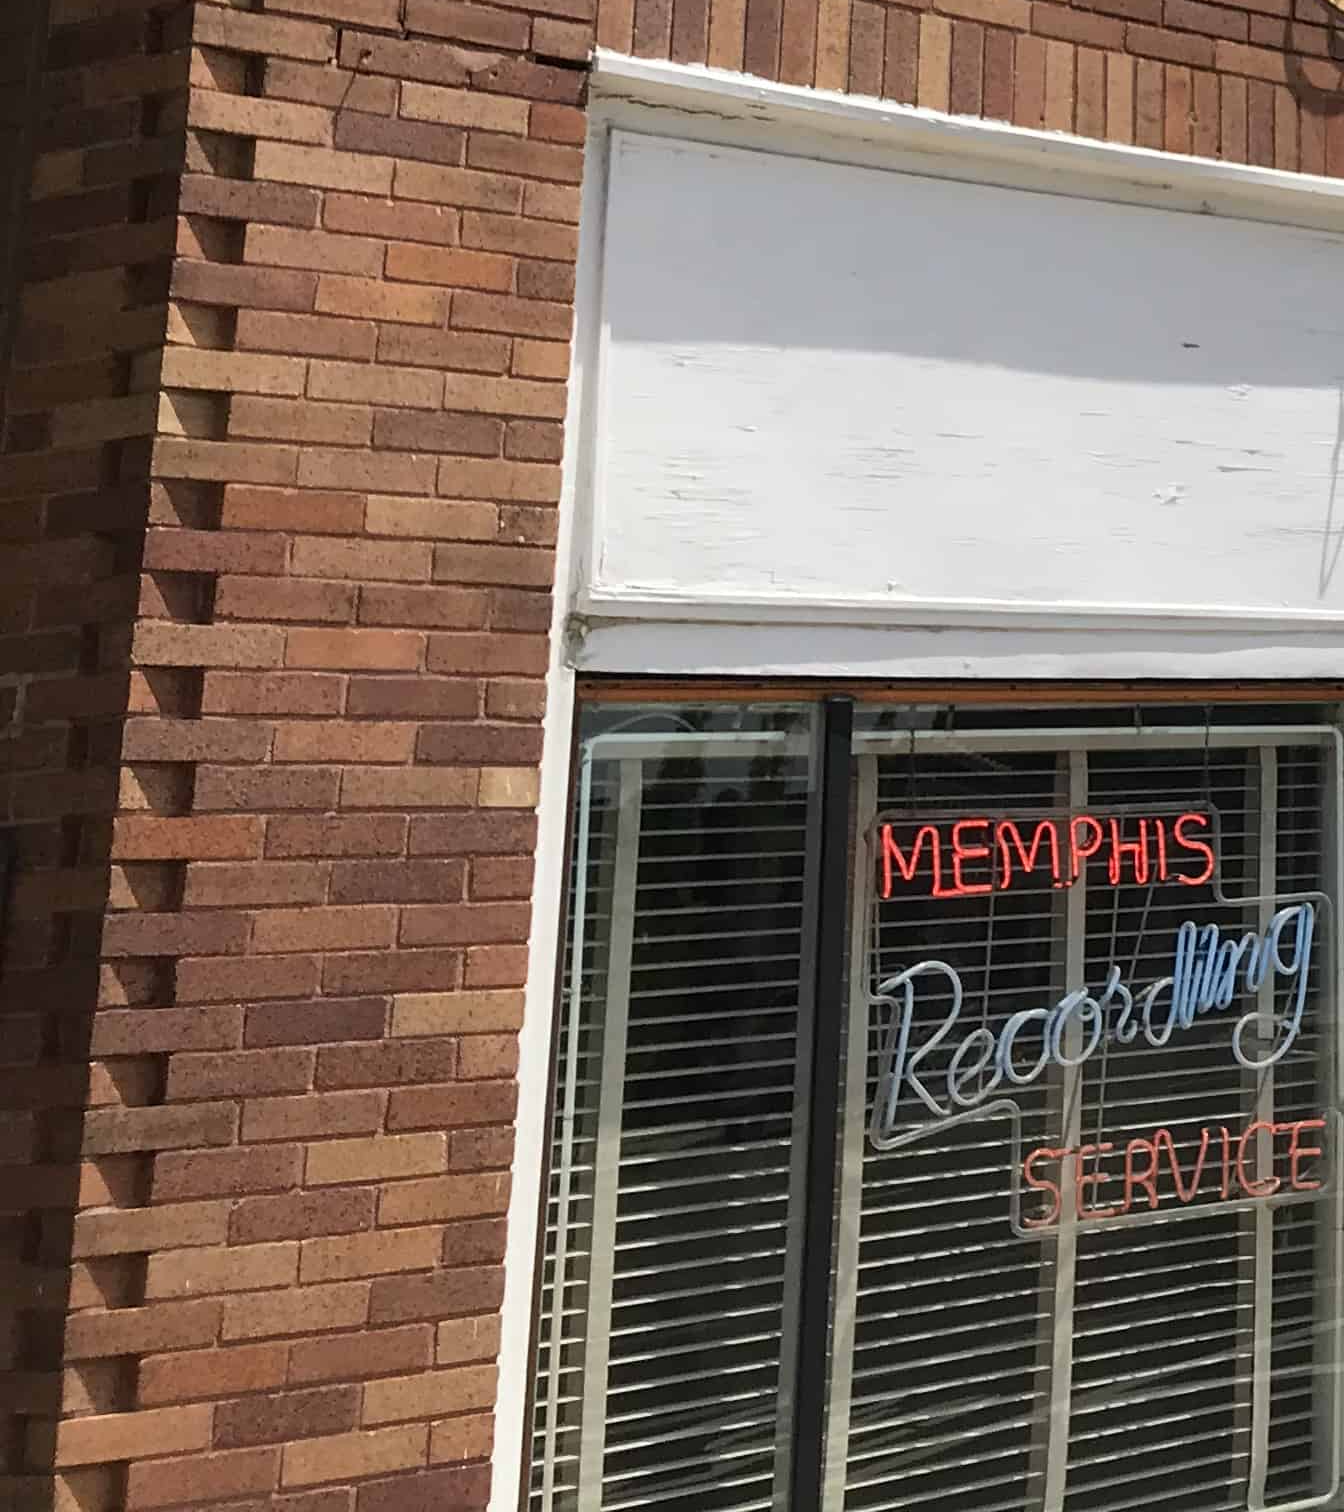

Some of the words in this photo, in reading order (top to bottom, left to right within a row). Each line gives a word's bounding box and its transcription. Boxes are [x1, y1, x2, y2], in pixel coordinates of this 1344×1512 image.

[880, 812, 1215, 899] MEMPHIS
[877, 902, 1315, 1131] Recording
[1023, 1120, 1326, 1228] SERVICE
